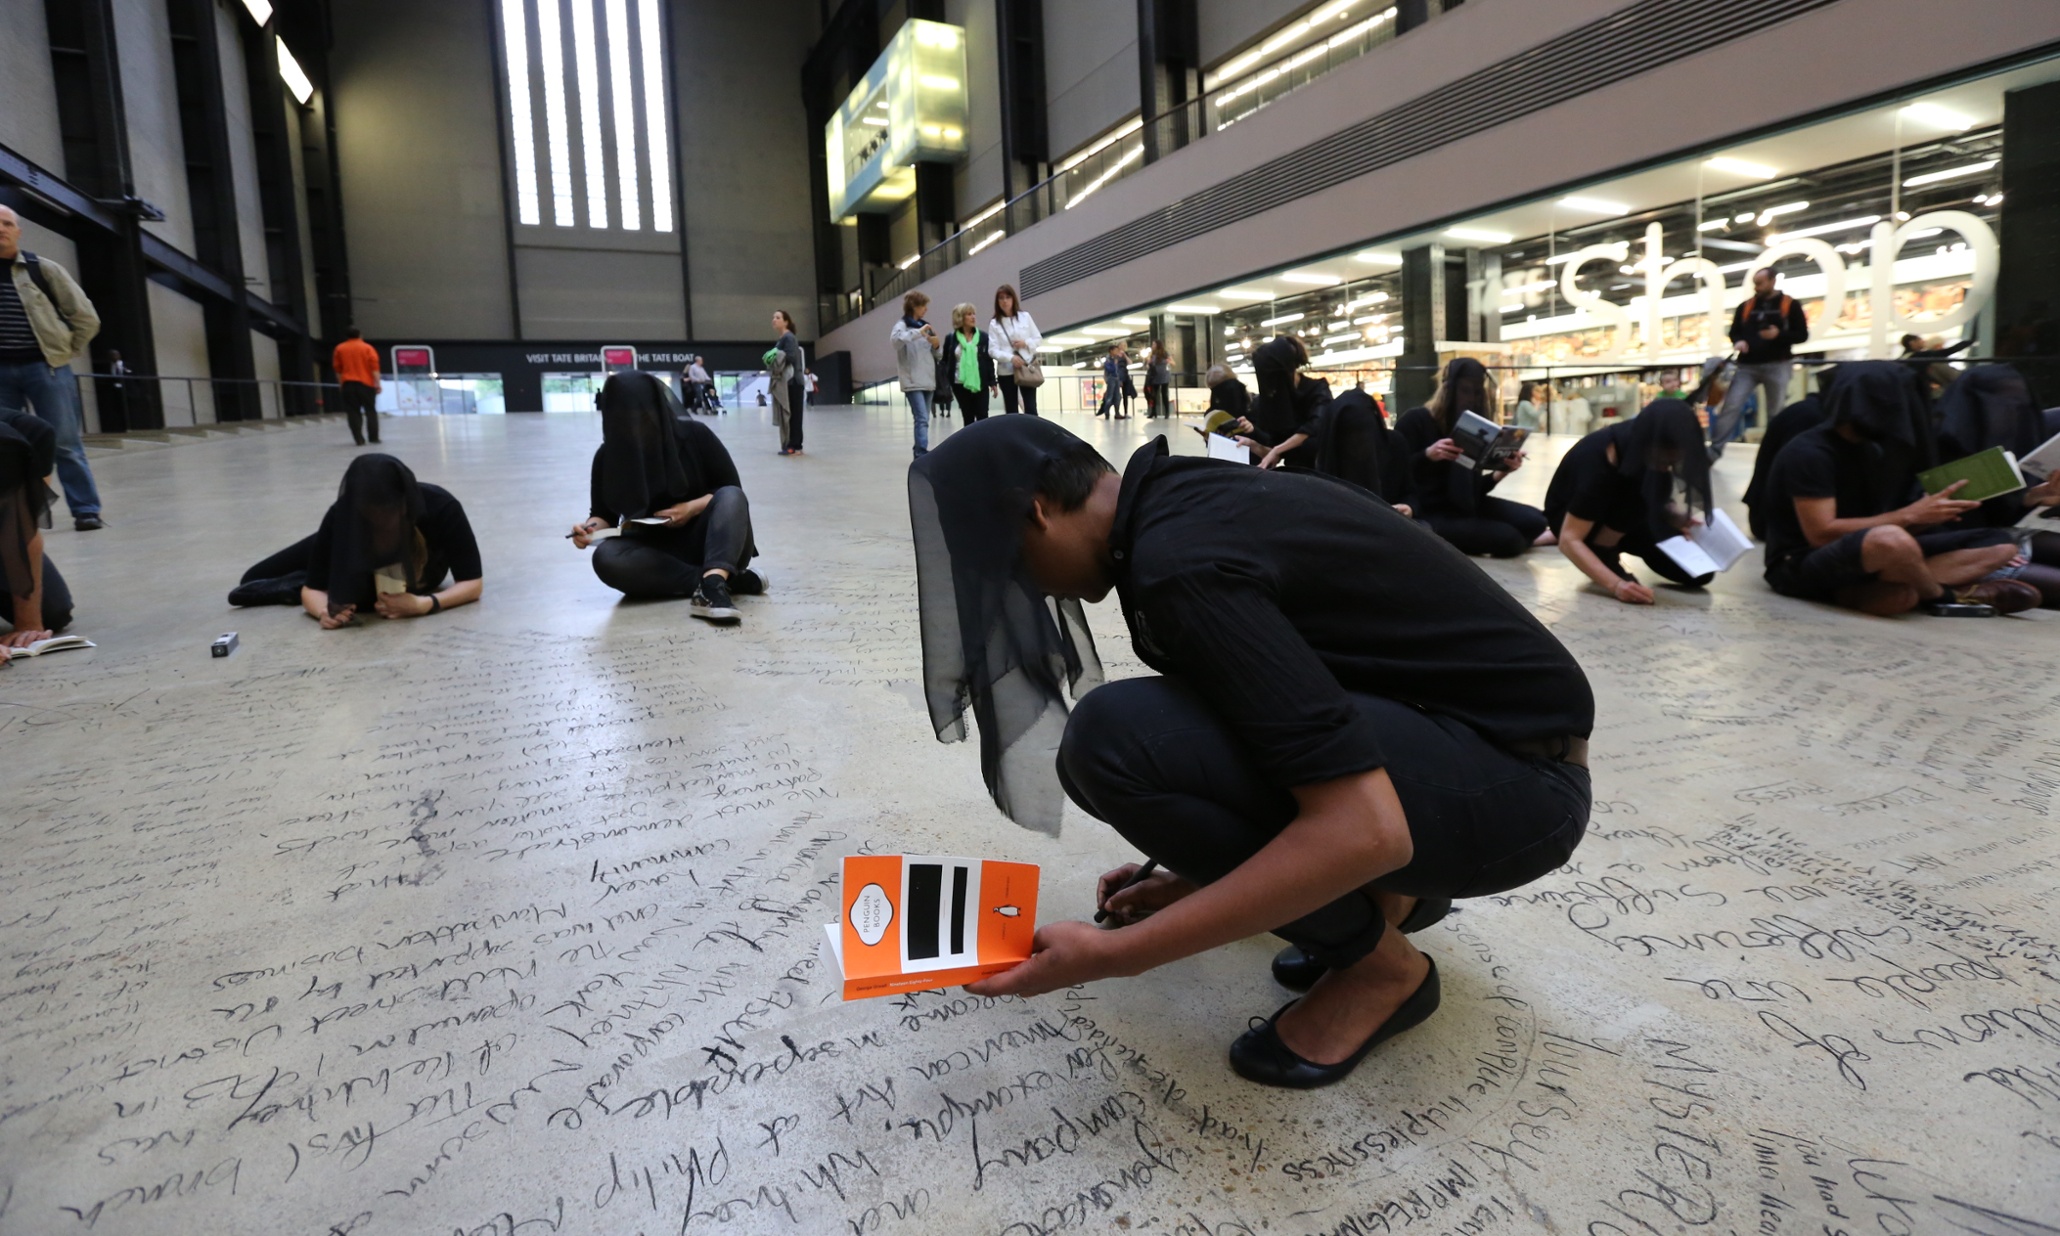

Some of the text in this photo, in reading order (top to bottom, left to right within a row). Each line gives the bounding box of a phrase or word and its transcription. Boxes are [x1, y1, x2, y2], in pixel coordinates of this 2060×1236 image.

[1560, 210, 2000, 363] shop
[526, 353, 550, 364] VISIT
[551, 353, 573, 364] TATE
[651, 353, 671, 363] TATE
[673, 353, 695, 363] BOAT
[889, 980, 908, 988] Nineteen
[909, 977, 933, 986] Eighty-Four
[828, 1077, 895, 1124] Art
[757, 1114, 800, 1156] at
